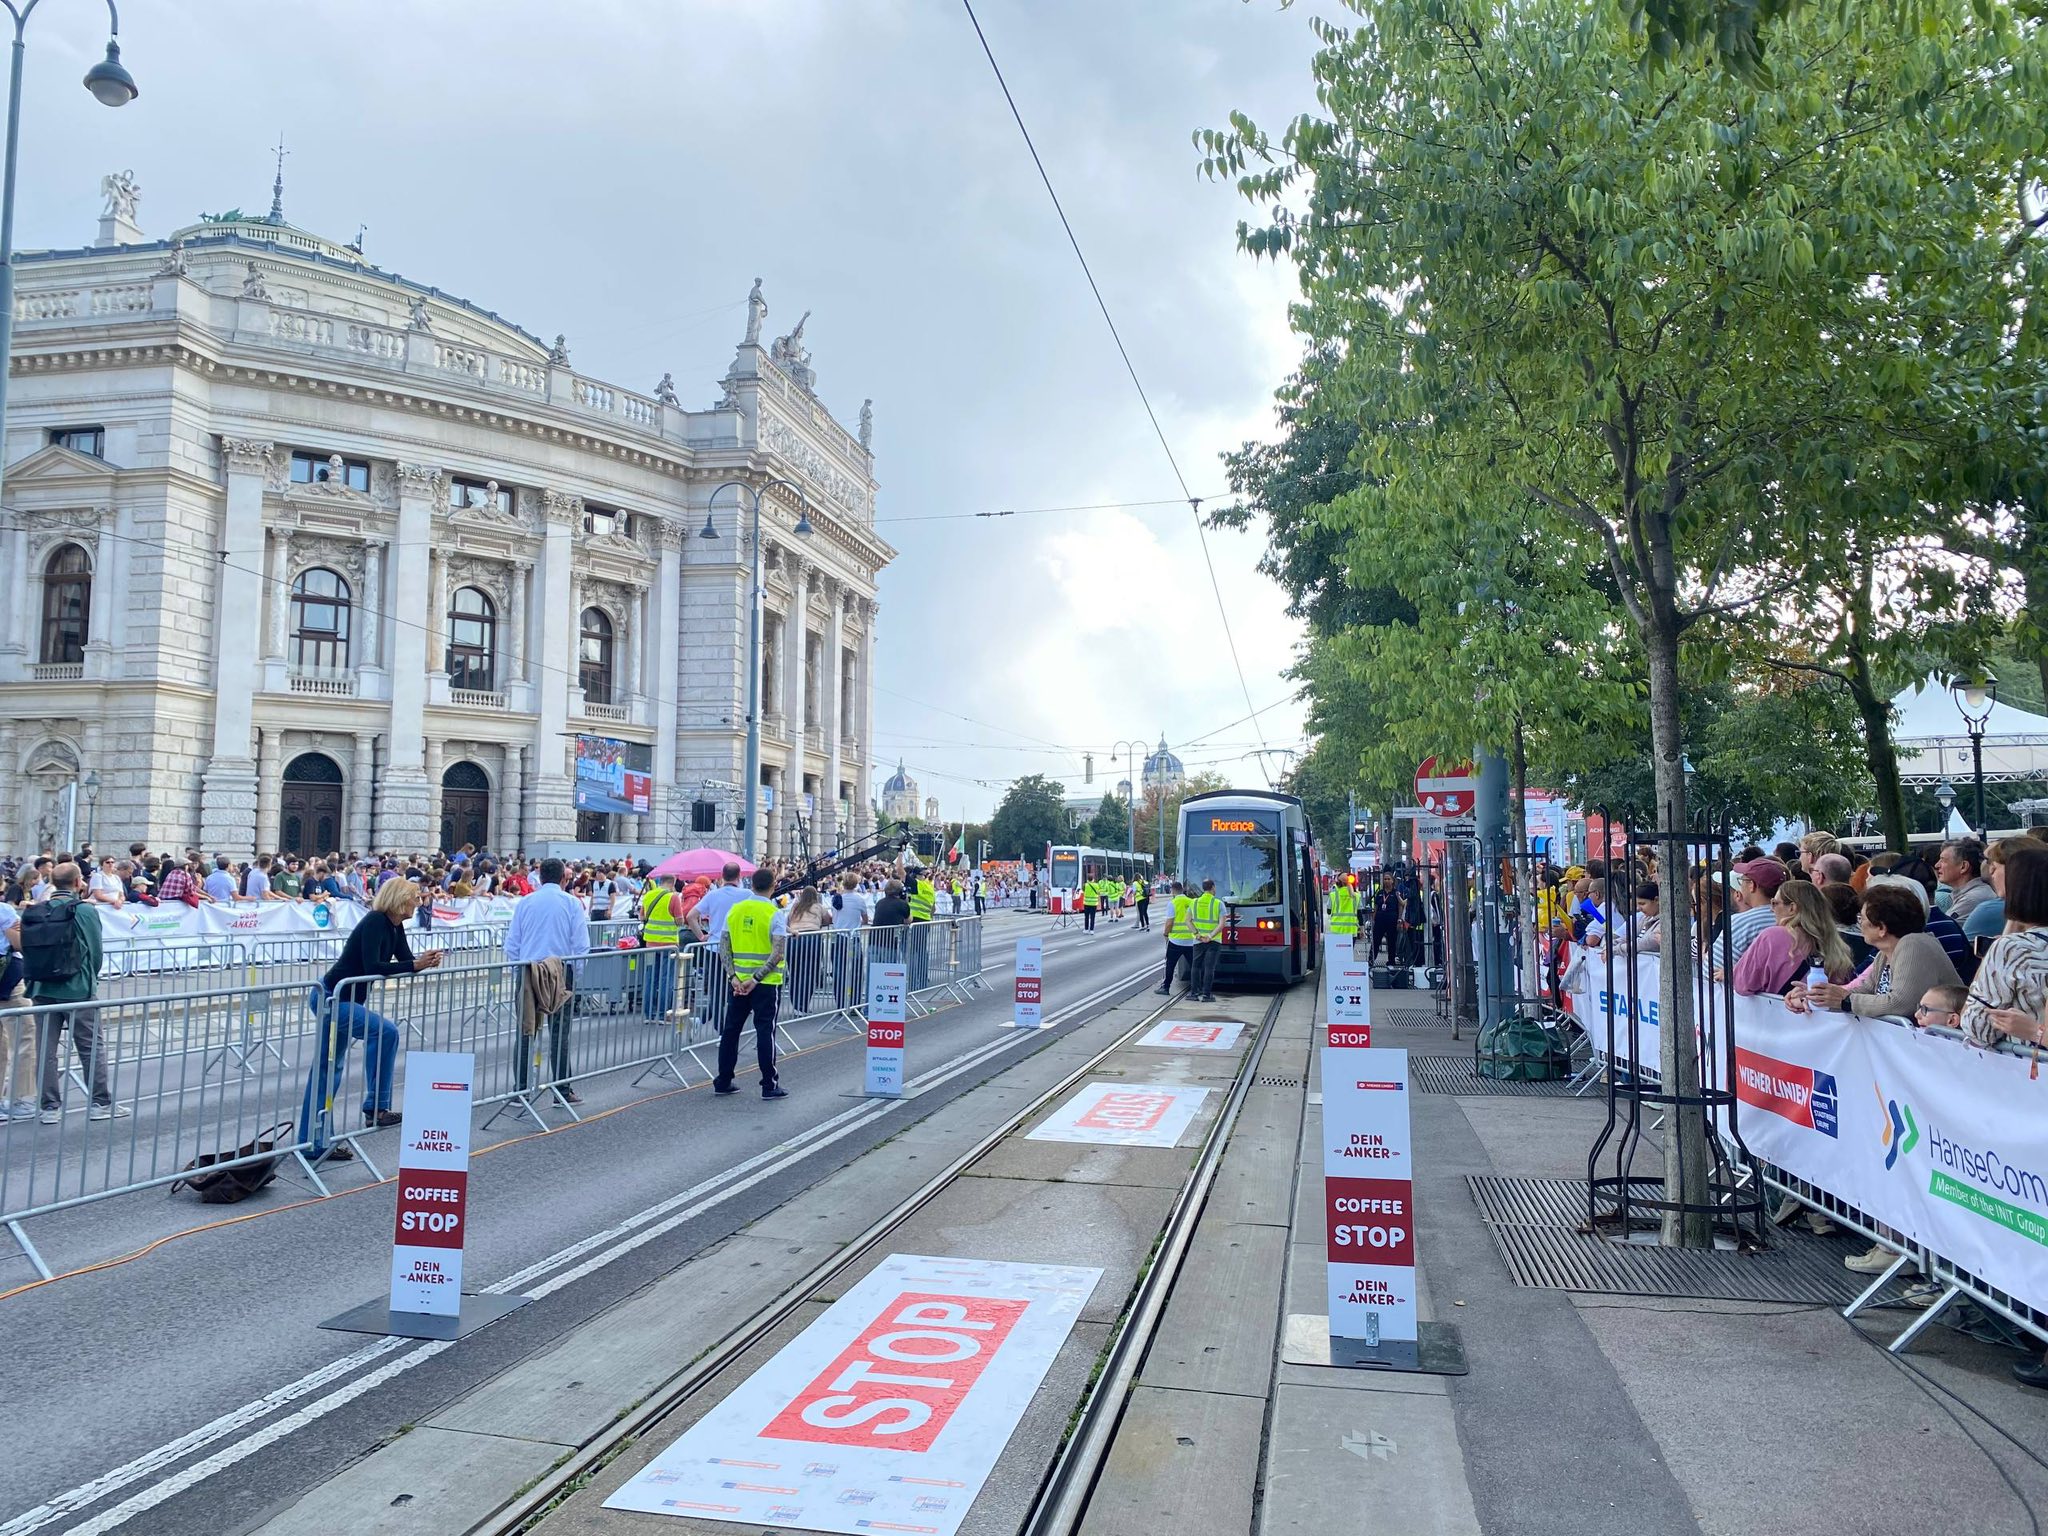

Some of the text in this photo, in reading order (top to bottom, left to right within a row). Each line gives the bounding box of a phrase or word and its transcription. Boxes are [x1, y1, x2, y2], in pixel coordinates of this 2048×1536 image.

[1211, 819, 1255, 831] Florence
[1418, 826, 1443, 834] ausgen.
[231, 920, 258, 929] ANKER
[1017, 991, 1039, 999] STOP
[869, 1029, 902, 1040] STOP
[1330, 1033, 1368, 1044] STOP
[1738, 1064, 1809, 1107] WIENER LINIEN
[422, 1129, 448, 1141] DEIN
[1350, 1133, 1383, 1146] DEIN
[415, 1141, 453, 1152] ANKER
[1343, 1146, 1390, 1159] ANKER
[1928, 1124, 2048, 1207] HanseCom
[404, 1187, 459, 1203] COFFEE
[1334, 1198, 1403, 1215] COFFEE
[1935, 1176, 2046, 1244] Member of the INIT Group
[401, 1211, 459, 1233] STOP
[1334, 1224, 1406, 1248] STOP
[414, 1261, 440, 1272] DEIN
[407, 1272, 445, 1285] ANKER
[1355, 1279, 1388, 1293] DEIN
[1348, 1293, 1395, 1306] ANKER
[801, 1301, 997, 1435] STOP
